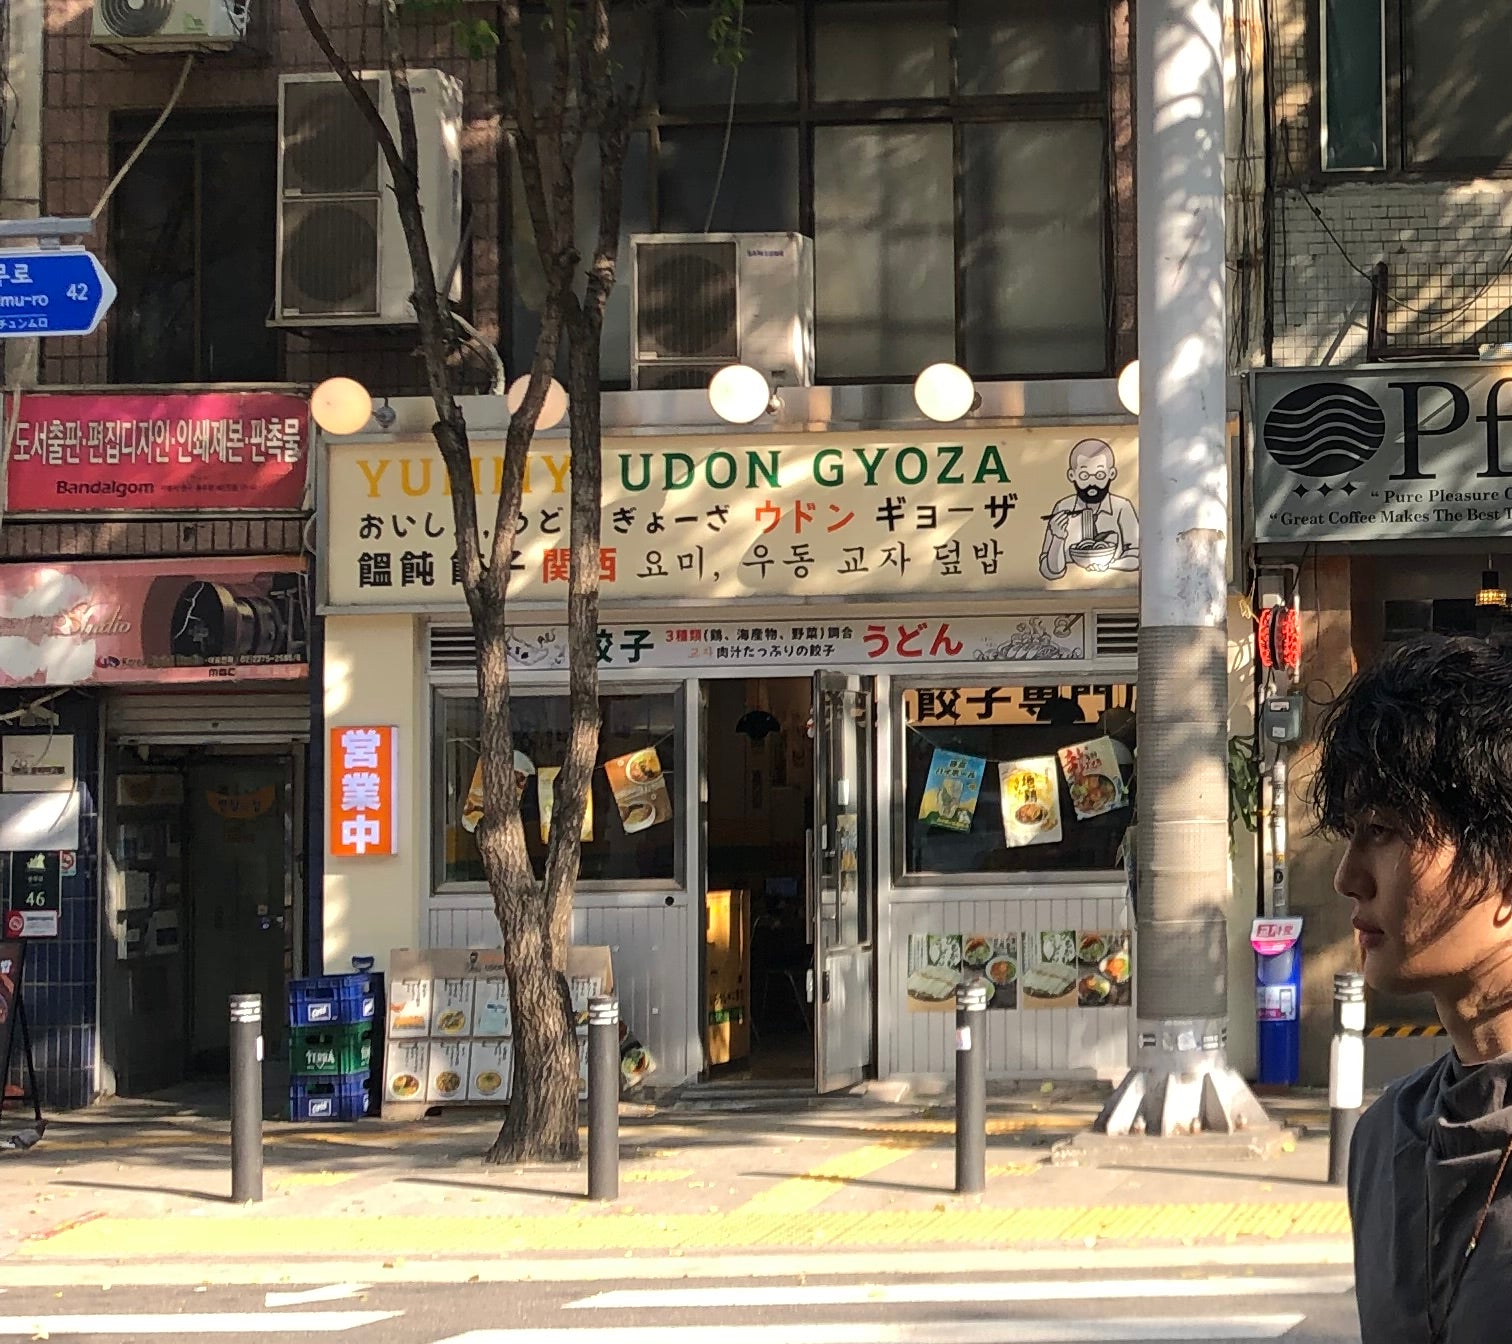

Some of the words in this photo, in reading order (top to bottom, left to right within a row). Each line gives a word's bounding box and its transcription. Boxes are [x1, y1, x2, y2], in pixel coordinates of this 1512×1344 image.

[66, 282, 88, 301] 42
[618, 450, 782, 492] UDON
[812, 445, 1012, 488] GYOZA
[56, 481, 154, 497] Bandalgom
[1384, 491, 1423, 504] Pure
[1428, 489, 1499, 503] Pleasure
[612, 503, 731, 535] ぎょーざ
[754, 499, 855, 535] ウドン
[875, 492, 1019, 533] ギョーザ
[1328, 511, 1377, 525] Coffee
[1380, 511, 1429, 524] Makes
[1432, 509, 1462, 523] The
[1467, 509, 1501, 522] Best
[741, 544, 816, 579] 우동
[836, 540, 912, 578] 교자
[932, 539, 1004, 577] 덮밥
[863, 623, 964, 659] うどん
[341, 728, 381, 855] 営業中
[25, 891, 46, 907] 46
